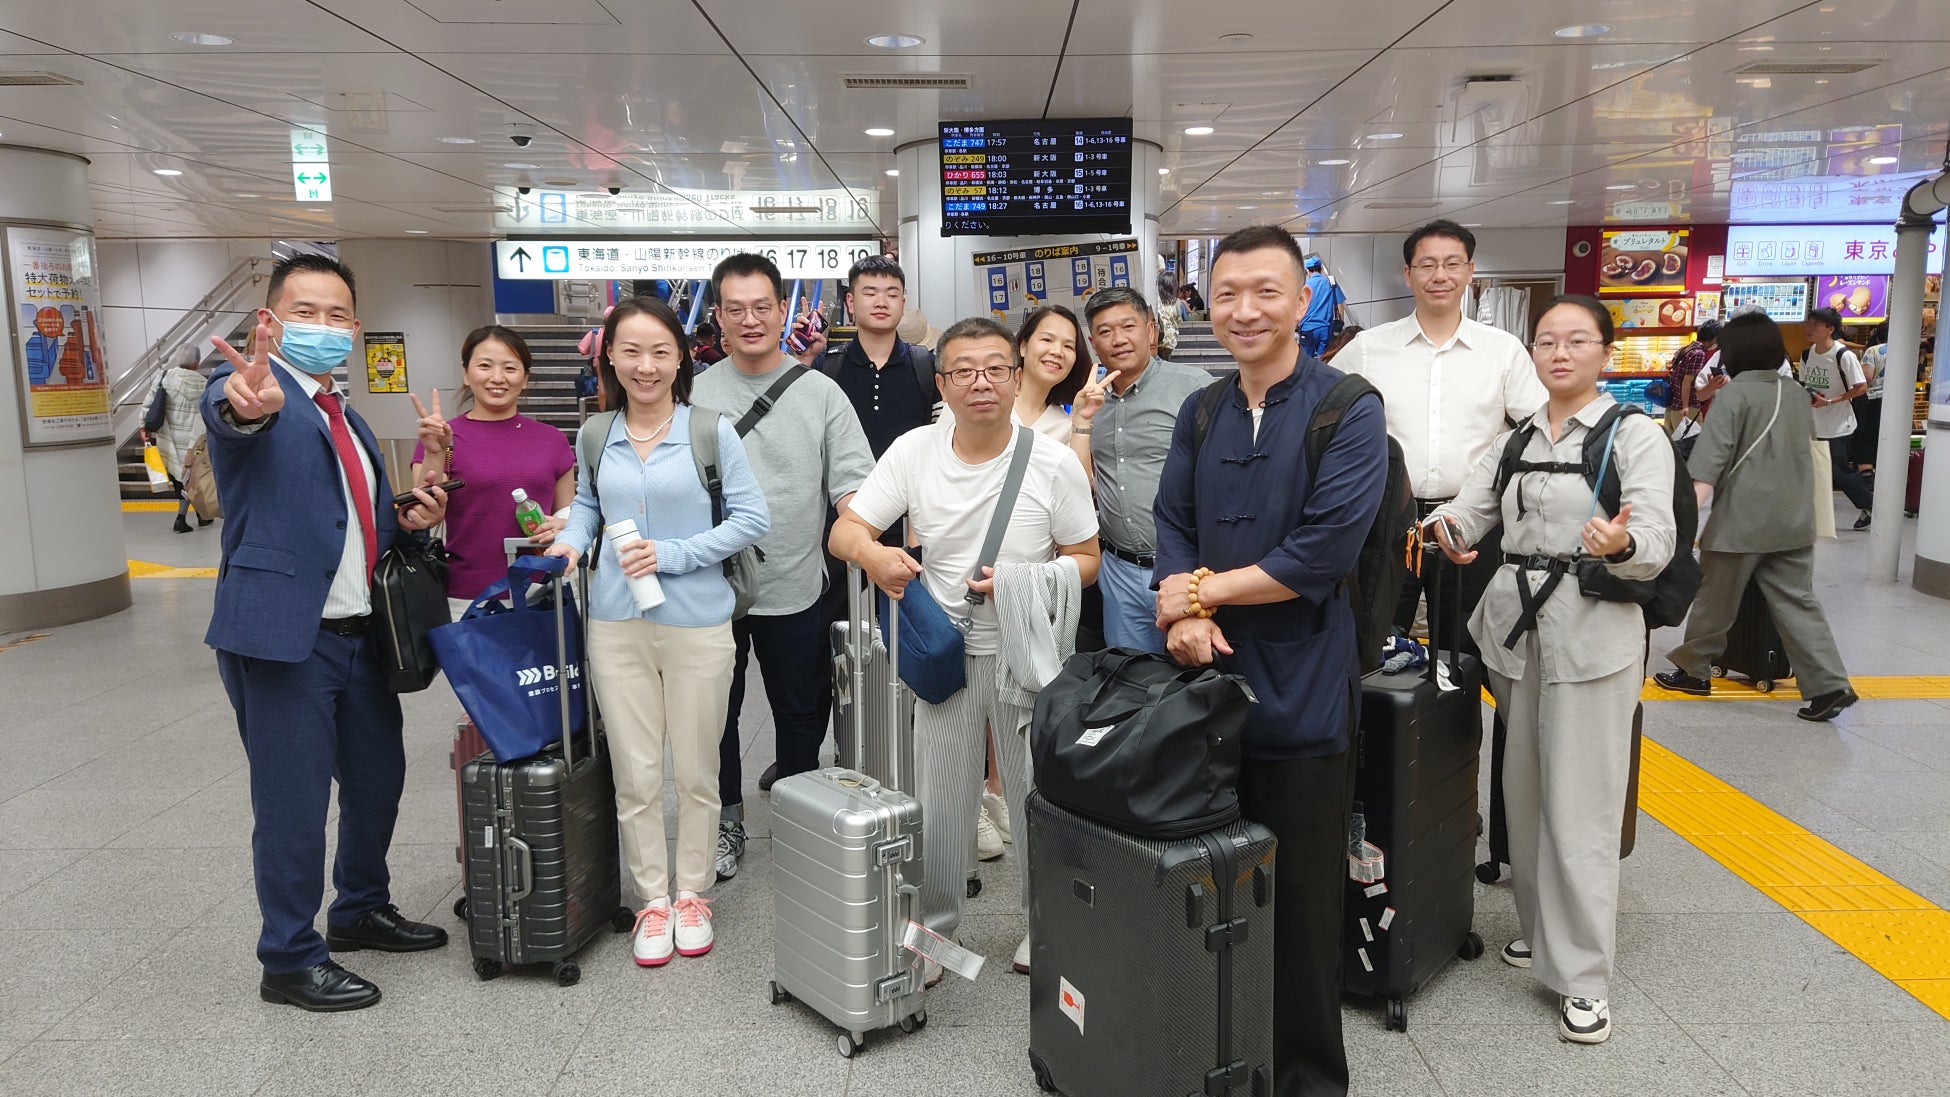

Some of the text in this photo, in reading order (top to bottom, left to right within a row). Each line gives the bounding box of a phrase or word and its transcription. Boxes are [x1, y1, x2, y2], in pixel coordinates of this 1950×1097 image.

[946, 139, 968, 147] こだま
[987, 138, 1007, 146] 17:57
[1033, 137, 1057, 146] 名古屋
[1075, 137, 1083, 145] 14
[1085, 137, 1113, 145] 1-6,13-16
[1033, 154, 1057, 162] 新大阪
[1075, 153, 1083, 161] 17
[947, 171, 969, 179] ひかり
[1033, 170, 1057, 178] 新大阪
[1075, 169, 1083, 177] 15
[947, 187, 970, 195] のぞみ
[1075, 184, 1083, 193] 19
[948, 203, 970, 211] こだま
[1033, 201, 1057, 210] 名古屋
[1075, 201, 1083, 209] 16
[945, 220, 990, 230] りください。
[1623, 237, 1666, 246] ブリュレタルト
[1034, 246, 1078, 258] のりば案内
[787, 249, 808, 269] 17
[817, 249, 839, 269] 18
[620, 264, 649, 274] Sanyo
[651, 263, 705, 273] Shinkansen
[1076, 263, 1086, 271] 18
[993, 277, 1003, 285] 16
[1032, 282, 1042, 290] 19
[1077, 278, 1087, 286] 19
[994, 294, 1004, 302] 17
[1806, 366, 1829, 377] FAST
[1805, 374, 1830, 385] FOODS
